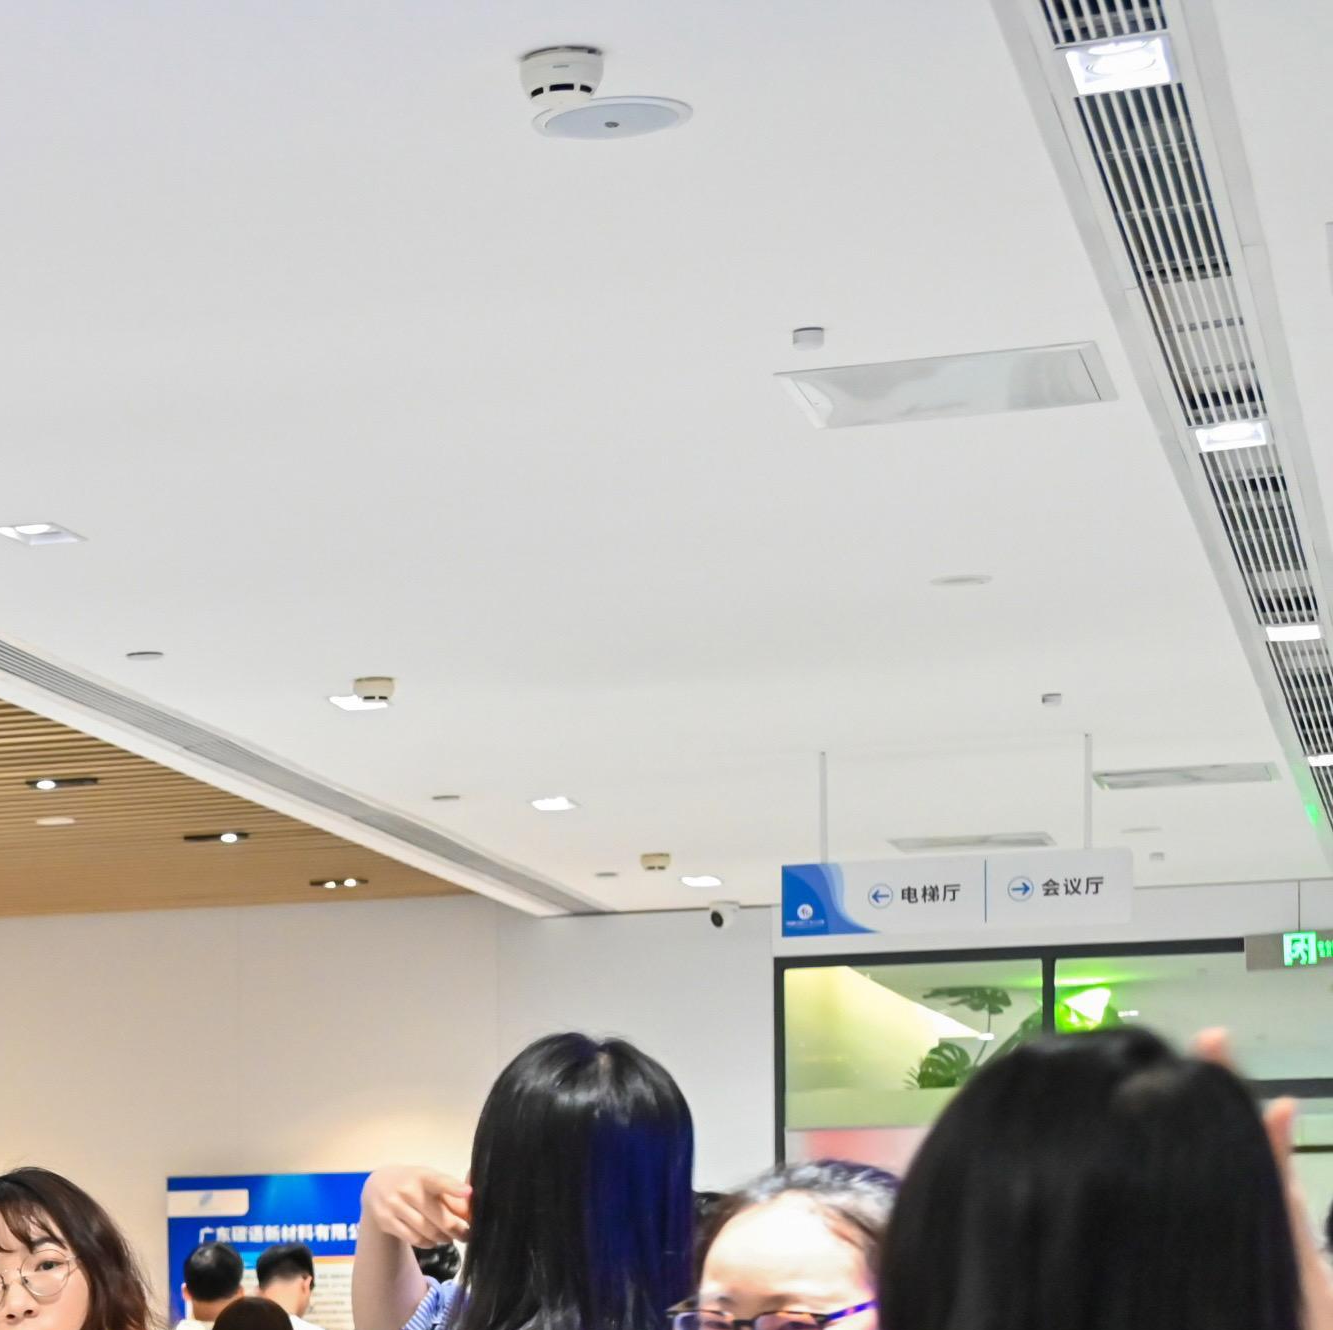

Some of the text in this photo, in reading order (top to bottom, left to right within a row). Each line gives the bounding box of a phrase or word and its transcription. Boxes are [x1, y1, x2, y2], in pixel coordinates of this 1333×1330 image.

[900, 883, 961, 905] 电梯厅
[1041, 876, 1105, 897] 会议厅
